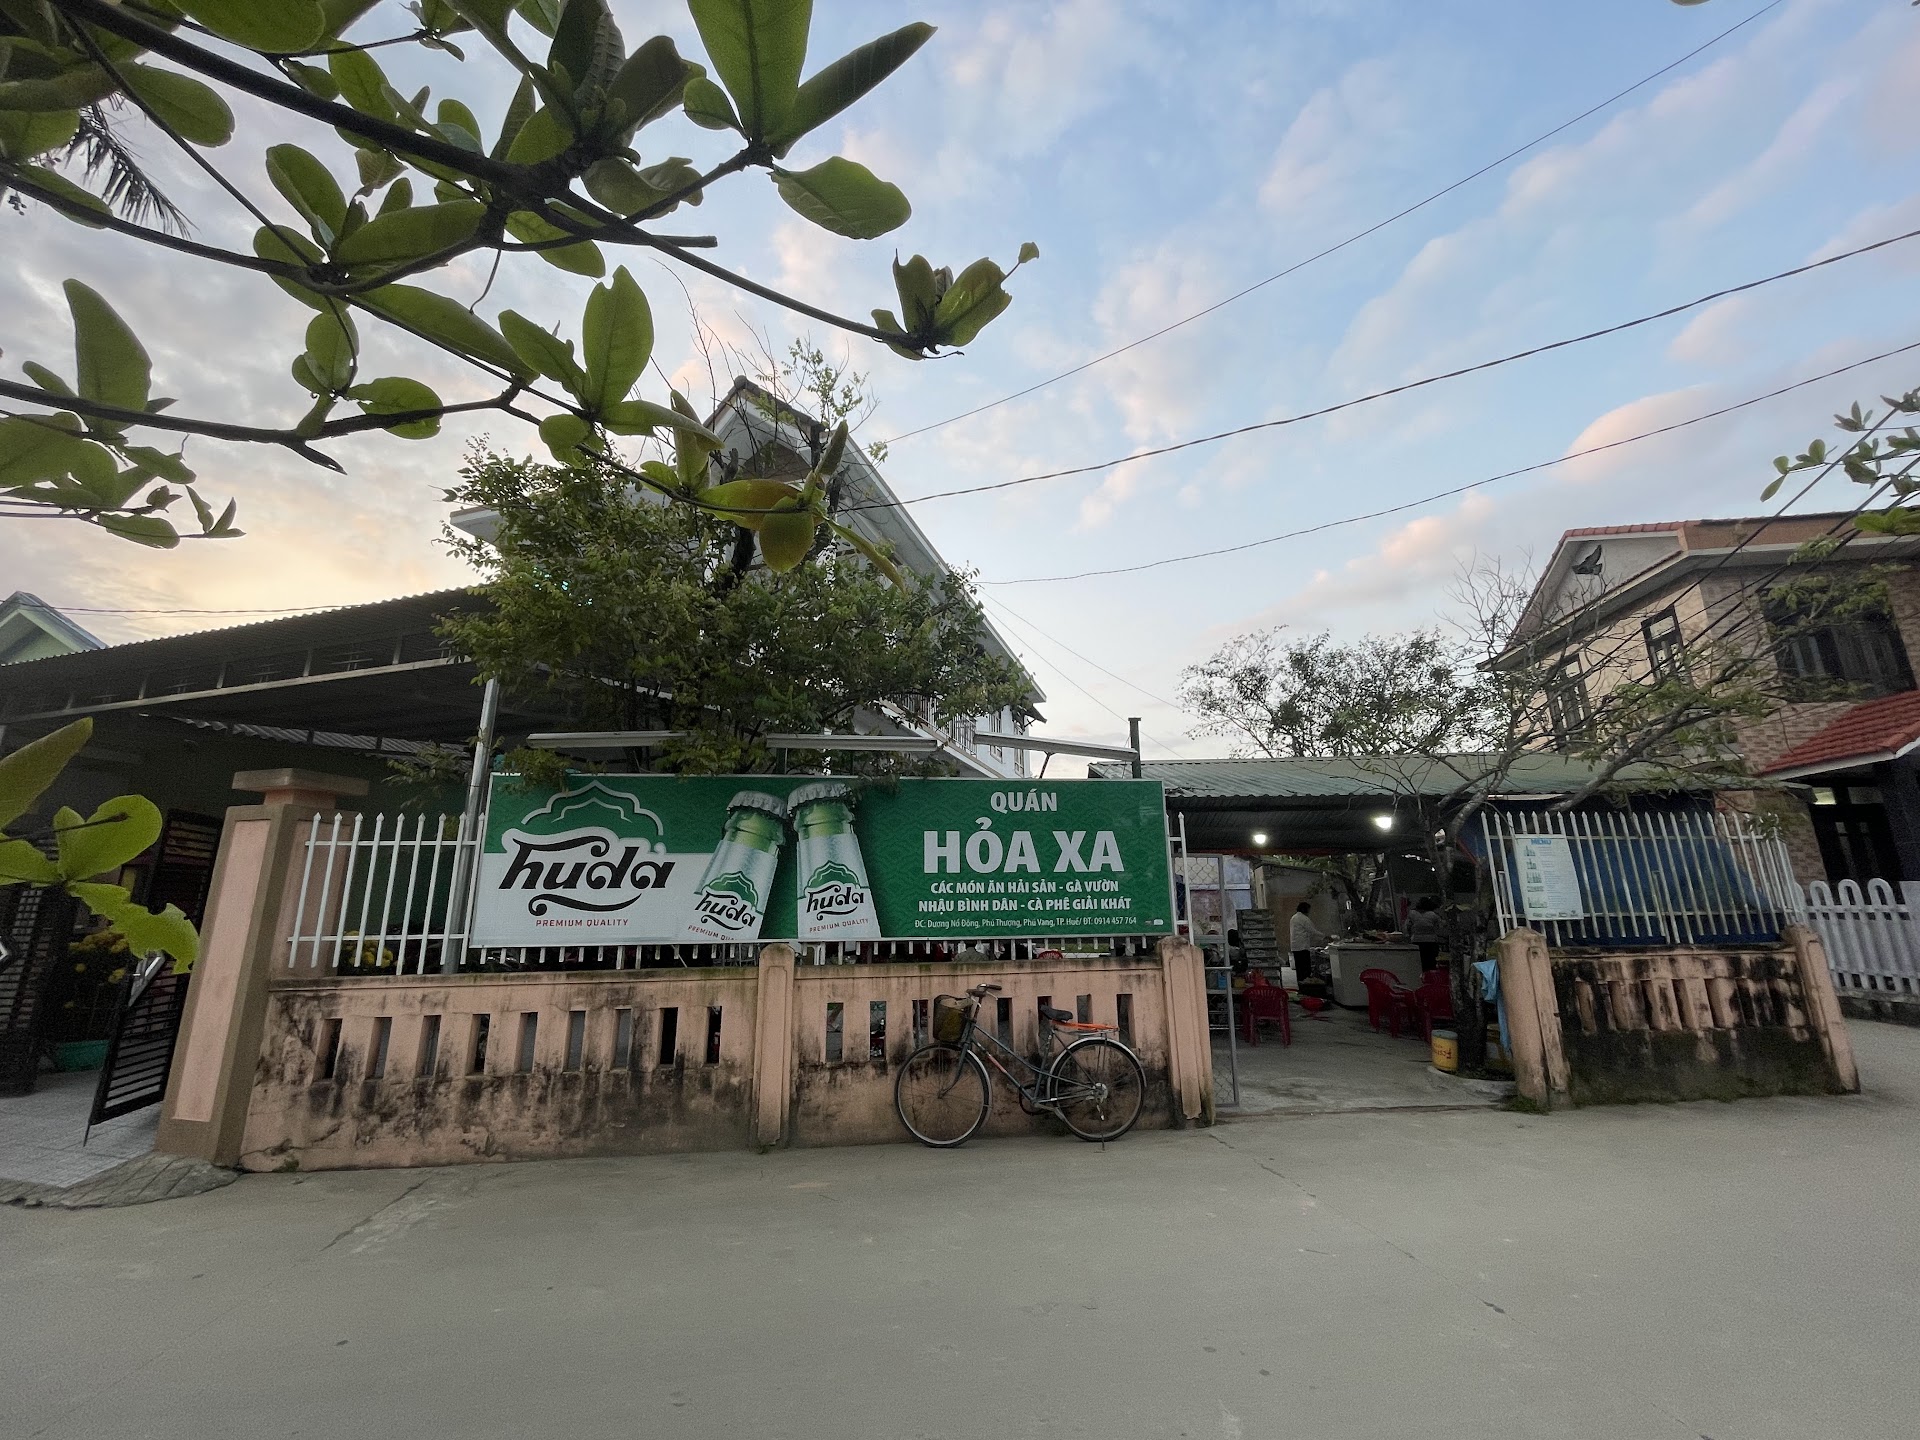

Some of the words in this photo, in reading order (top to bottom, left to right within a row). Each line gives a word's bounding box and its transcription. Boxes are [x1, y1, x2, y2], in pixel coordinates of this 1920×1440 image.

[990, 788, 1058, 814] QUÁN
[923, 816, 1041, 874] HỎA
[1052, 830, 1125, 873] XA
[498, 836, 676, 890] huda
[930, 880, 954, 894] CÁC
[956, 880, 985, 893] MÓN
[987, 880, 1005, 893] ĂN
[1007, 878, 1030, 893] HẢI
[1032, 878, 1057, 893] SẢN
[1065, 879, 1083, 893] GÀ
[1084, 878, 1119, 893] VƯỜN
[806, 884, 865, 913] huda
[918, 898, 955, 915] NHẬU
[957, 897, 989, 912] BÌNH
[992, 897, 1018, 911] DÂN
[1027, 897, 1043, 911] CÀ
[1045, 896, 1071, 911] PHÊ
[1072, 895, 1098, 910] GIẢI
[1100, 896, 1132, 909] KHÁT
[694, 890, 756, 928] huda
[535, 919, 583, 927] PREMIUM
[586, 918, 629, 928] QUALITY
[688, 924, 719, 938] PREMIUM
[809, 922, 840, 933] PREMIUM
[981, 918, 995, 927] Phú
[1023, 918, 1036, 927] Phú
[1094, 916, 1111, 925] 0914
[1111, 916, 1124, 925] 457
[1124, 916, 1137, 925] 764
